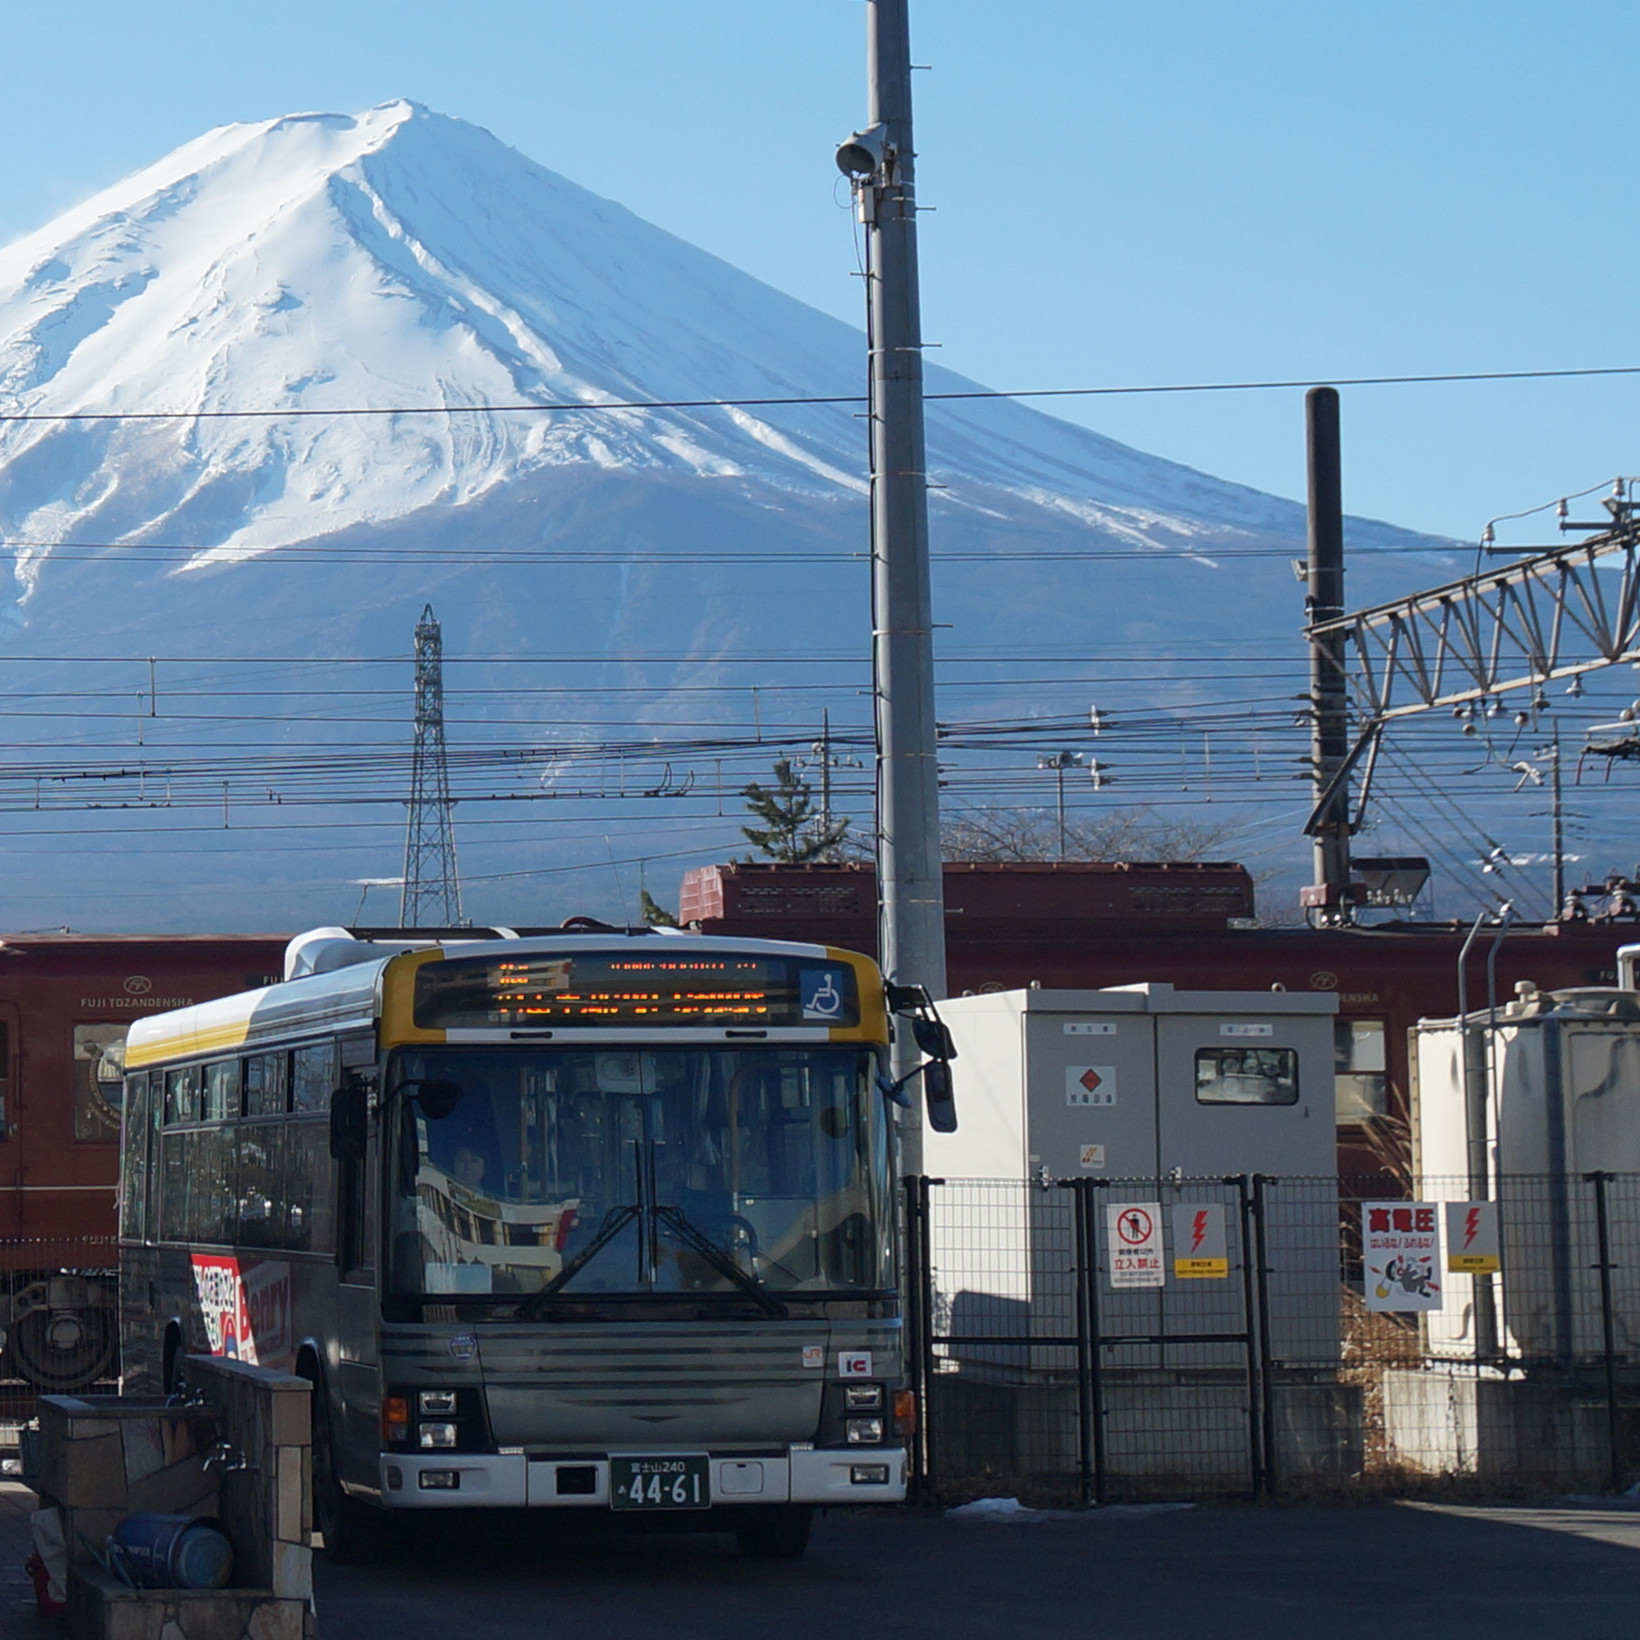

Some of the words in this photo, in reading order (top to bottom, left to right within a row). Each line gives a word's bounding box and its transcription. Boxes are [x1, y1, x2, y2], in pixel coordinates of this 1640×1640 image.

[81, 998, 105, 1008] FUJI
[109, 998, 194, 1008] TOZANDENSHA
[1368, 1208, 1434, 1232] 高電圧
[1114, 1258, 1160, 1270] 立入禁止
[803, 1348, 821, 1359] JR
[630, 1474, 700, 1503] 44-61
